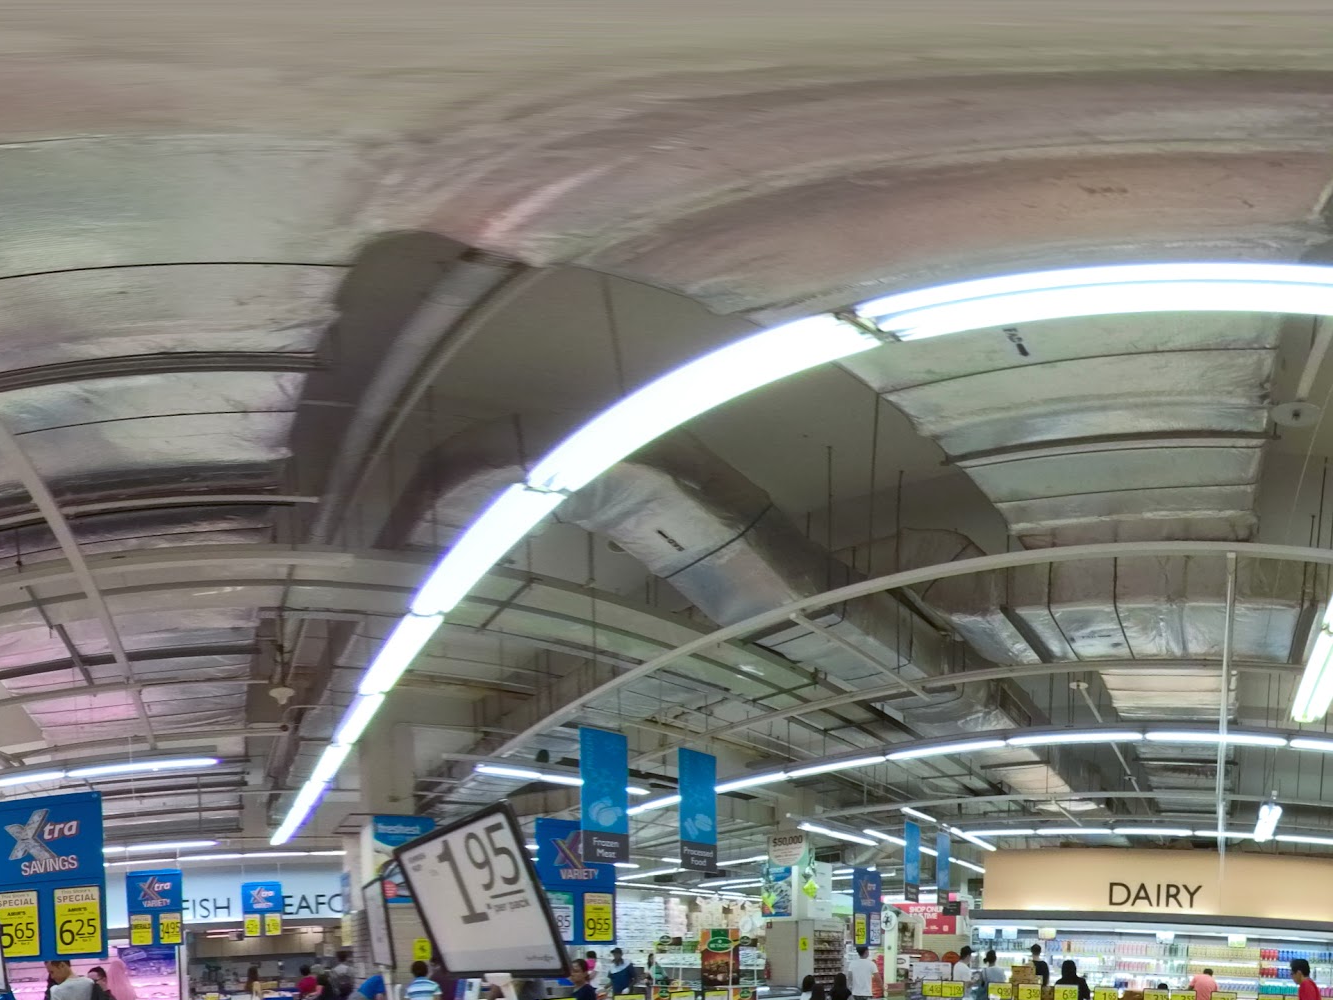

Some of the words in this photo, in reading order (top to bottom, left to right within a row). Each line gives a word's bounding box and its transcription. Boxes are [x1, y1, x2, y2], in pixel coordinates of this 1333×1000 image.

[4, 808, 80, 861] Xtra
[593, 837, 620, 847] Frozen
[773, 835, 803, 846] $50,000
[596, 849, 617, 858] Meat
[683, 847, 714, 858] Processed
[21, 855, 79, 876] SAVINGS
[690, 857, 708, 866] Food
[559, 868, 599, 880] VARIETY
[137, 876, 172, 901] Xtra
[56, 894, 96, 903] SPECIAL
[1108, 882, 1203, 908] DAIRY
[142, 898, 171, 908] VARIETY
[282, 893, 342, 915] EAFO
